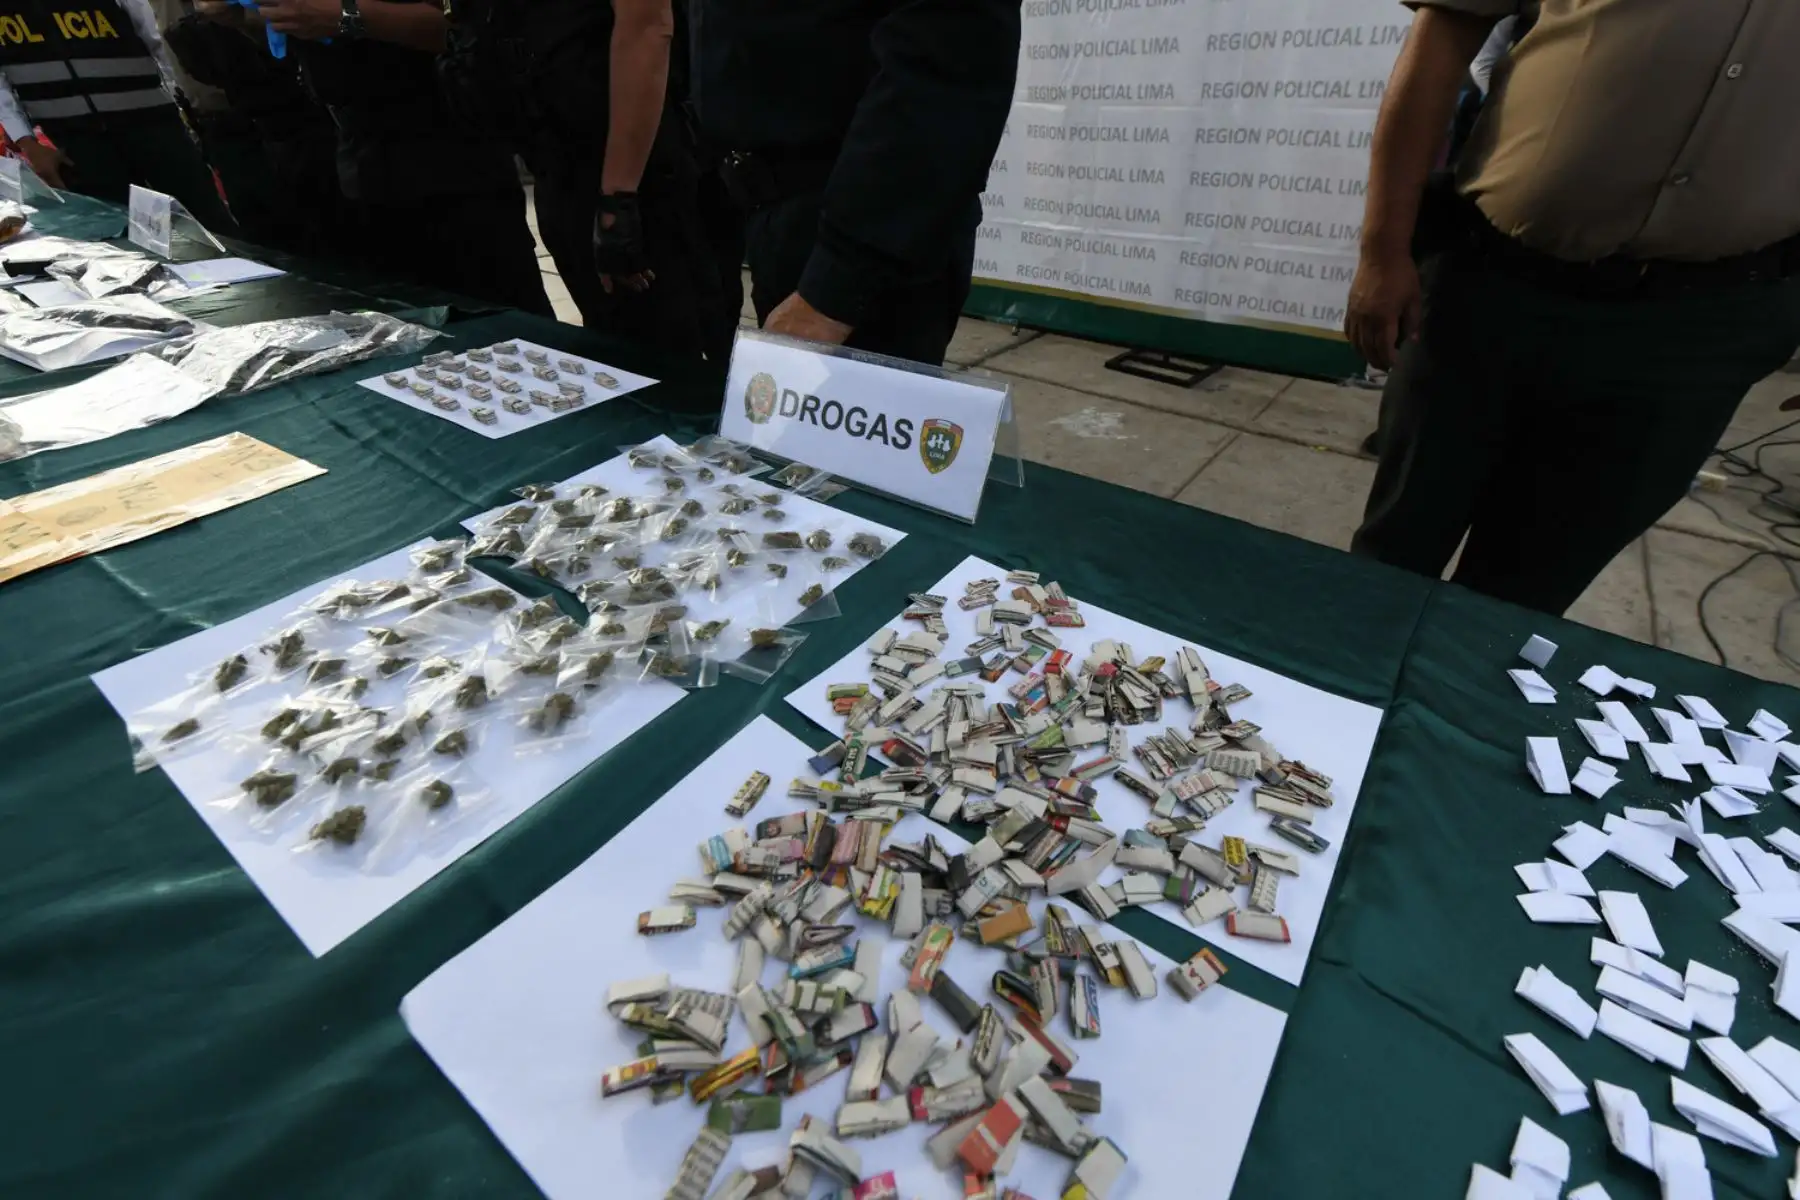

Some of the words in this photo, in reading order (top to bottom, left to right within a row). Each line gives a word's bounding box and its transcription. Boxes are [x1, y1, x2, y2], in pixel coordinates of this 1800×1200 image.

[1025, 0, 1071, 19] REGION
[1027, 44, 1070, 60] REGION
[1074, 39, 1137, 58] POLICIAL
[1141, 37, 1180, 55] LIMA
[1206, 31, 1277, 52] REGION
[1282, 26, 1363, 49] POLICIAL
[1369, 25, 1409, 45] LIM
[1027, 85, 1067, 101] REGION
[1072, 83, 1133, 100] POLICIAL
[1137, 83, 1174, 100] LIMA
[1201, 80, 1270, 99] REGION
[1274, 79, 1352, 99] POLICIAL
[1027, 124, 1065, 141] REGION
[1069, 126, 1129, 143] POLICIAL
[1133, 127, 1170, 144] LIMA
[1195, 127, 1261, 145] REGION
[1266, 128, 1341, 148] POLICIAL
[1026, 161, 1064, 179] REGION
[1068, 165, 1125, 183] POLICIAL
[1129, 168, 1165, 184] LIMA
[1189, 171, 1254, 188] REGION
[1258, 173, 1333, 195] POLICIAL
[1338, 178, 1369, 197] LIM
[982, 194, 1004, 208] IMA
[1023, 197, 1063, 215] REGION
[1067, 202, 1121, 221] POLICIAL
[1125, 207, 1160, 224] LIMA
[977, 227, 1002, 240] IMA
[1185, 212, 1246, 229] REGION
[1251, 216, 1323, 238] POLICIAL
[1328, 223, 1362, 241] LIM
[1020, 231, 1062, 249] REGION
[1065, 238, 1118, 257] POLICIAL
[1122, 244, 1156, 262] LIMA
[974, 258, 998, 273] IMA
[1180, 250, 1239, 270] REGION
[1244, 257, 1315, 279] POLICIAL
[1320, 265, 1353, 283] LIM
[1016, 264, 1060, 281] REGION
[1064, 271, 1116, 292] POLICIAL
[1119, 279, 1152, 297] LIMA
[1174, 288, 1232, 308] REGION
[1237, 294, 1306, 318] POLICIAL
[1312, 305, 1345, 323] LIM
[779, 388, 914, 450] DROGAS
